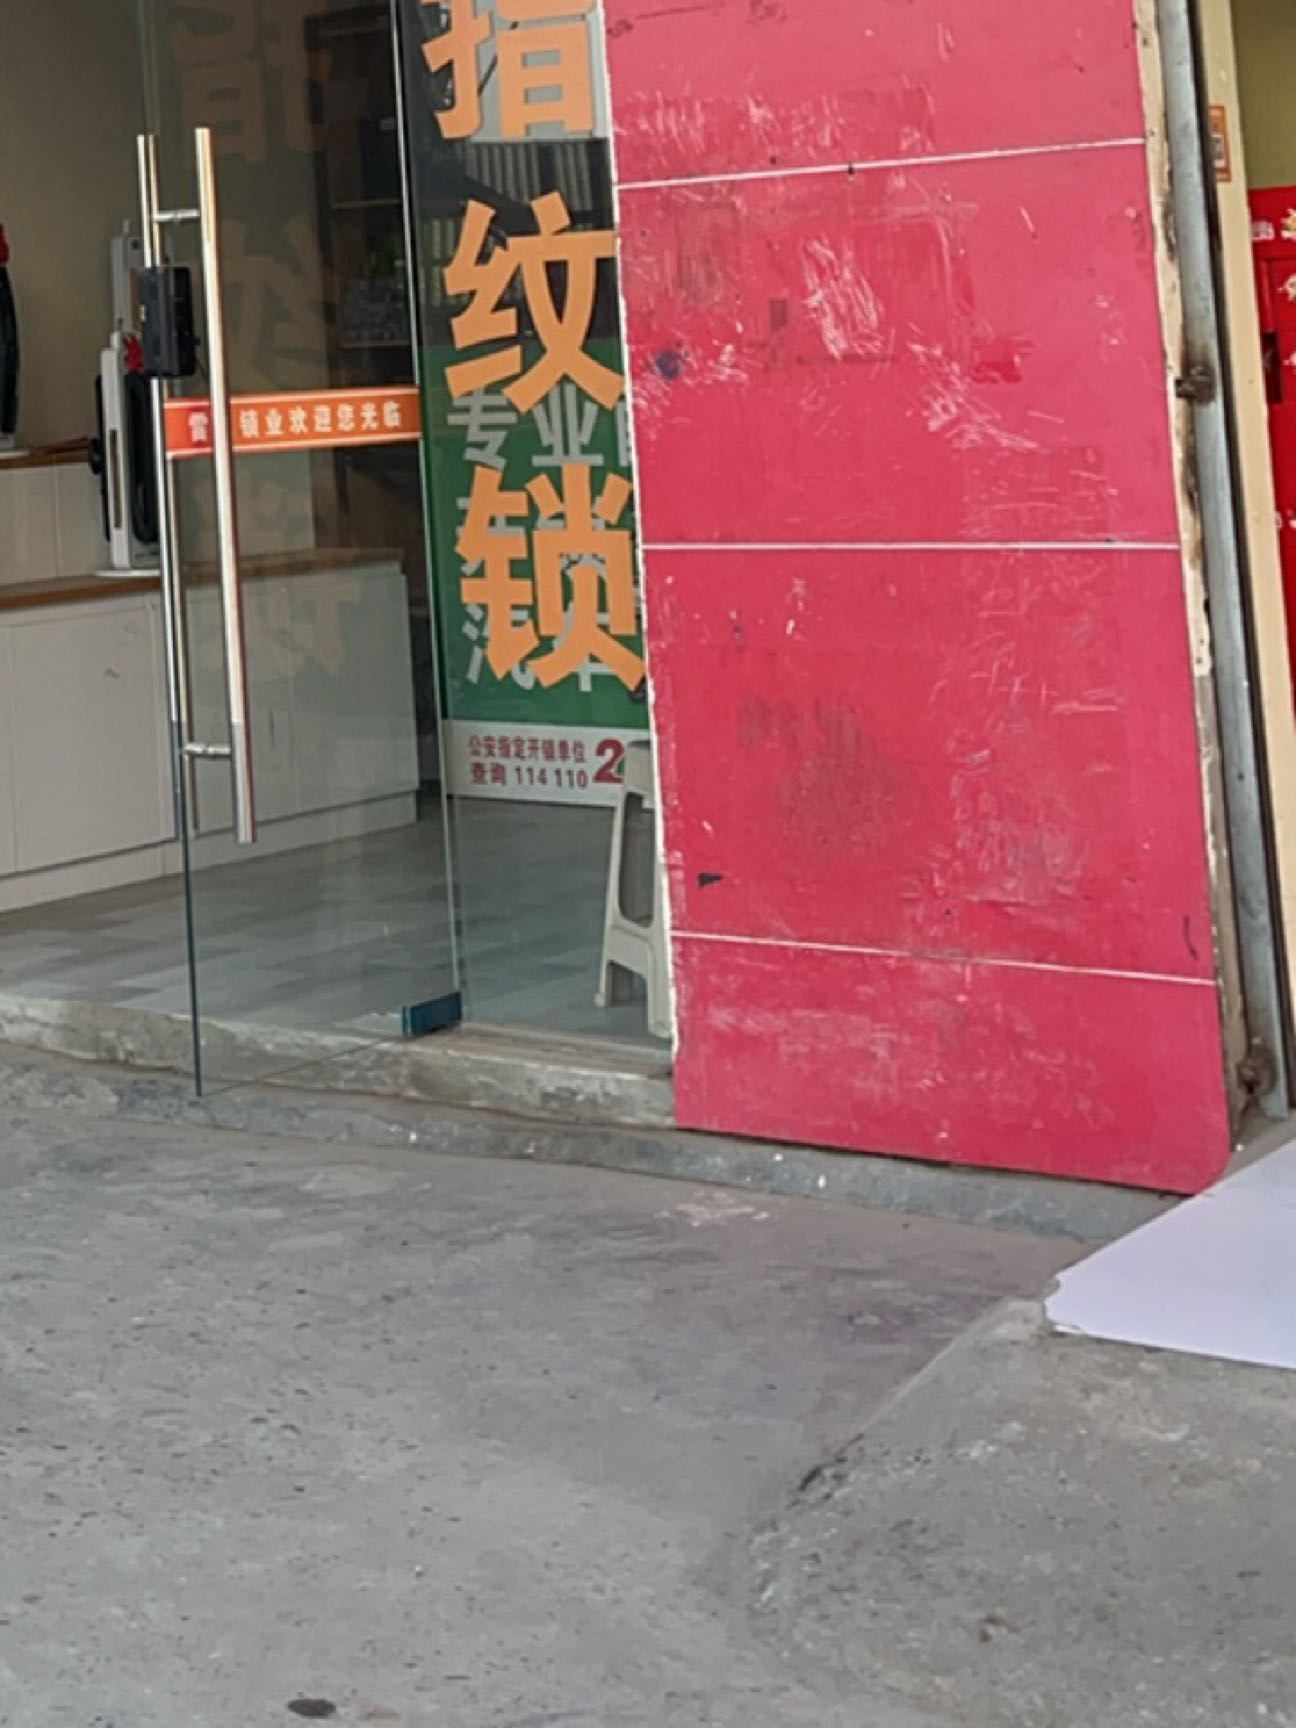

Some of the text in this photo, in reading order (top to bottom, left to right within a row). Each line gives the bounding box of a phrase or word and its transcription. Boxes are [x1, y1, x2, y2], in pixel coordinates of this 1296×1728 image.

[187, 399, 403, 443] 雷锁业欢迎您光临
[515, 765, 548, 786] 114
[554, 767, 588, 789] 110
